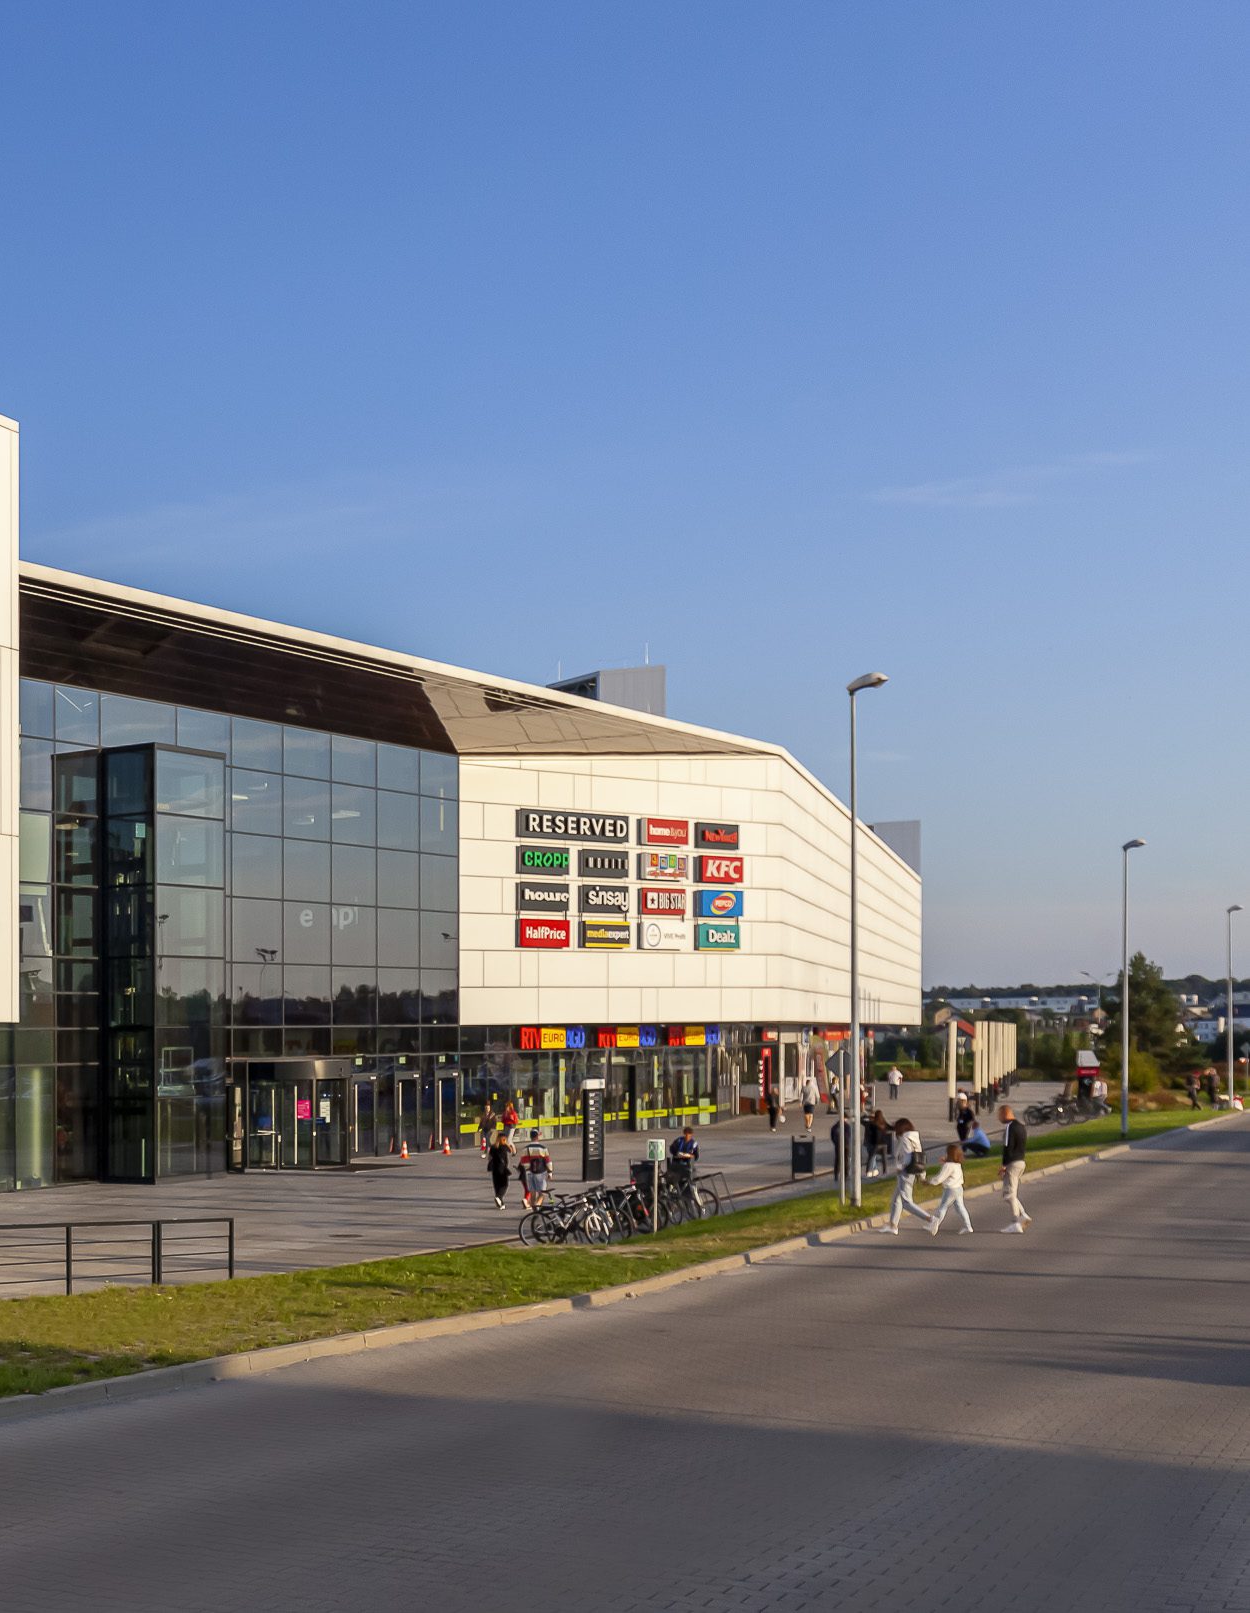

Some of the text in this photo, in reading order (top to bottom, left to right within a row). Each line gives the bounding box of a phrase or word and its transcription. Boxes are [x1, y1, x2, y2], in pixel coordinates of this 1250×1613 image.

[528, 813, 627, 837] RESERVED
[524, 851, 569, 868] CROPP
[705, 859, 741, 879] KFC
[588, 886, 629, 911] sinsay
[658, 892, 669, 909] BIG
[526, 926, 566, 940] HalfPrice
[708, 929, 736, 943] Dealz
[520, 1027, 586, 1049] RTV EURO AGD
